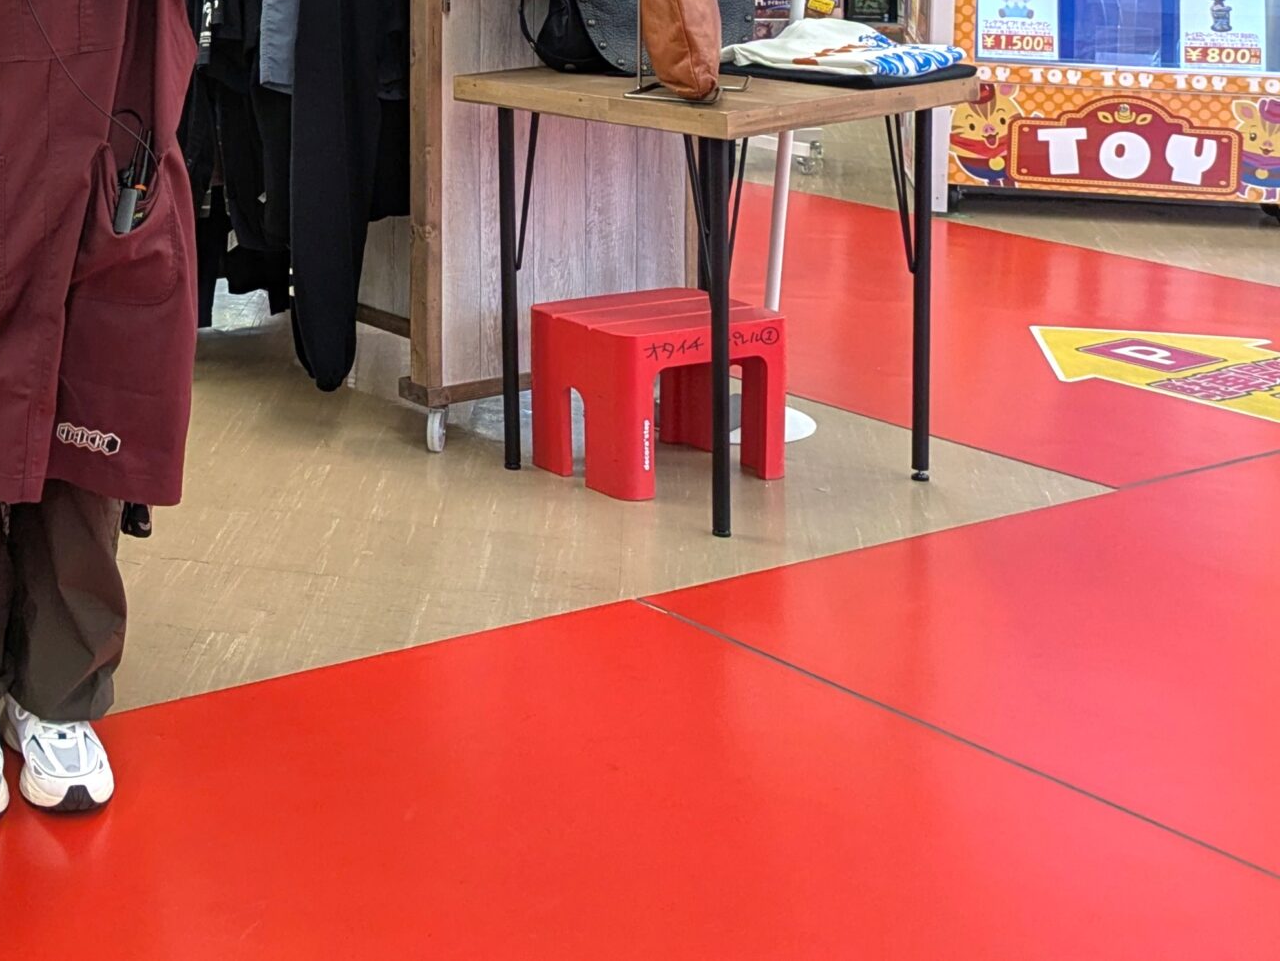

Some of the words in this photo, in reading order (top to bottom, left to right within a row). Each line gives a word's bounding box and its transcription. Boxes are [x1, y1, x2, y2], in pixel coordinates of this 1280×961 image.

[976, 65, 1010, 82] OY
[1029, 67, 1082, 85] TOY
[1100, 70, 1154, 89] TOY
[1173, 73, 1228, 90] TOY
[1246, 76, 1280, 94] TO
[1037, 126, 1218, 186] TOY
